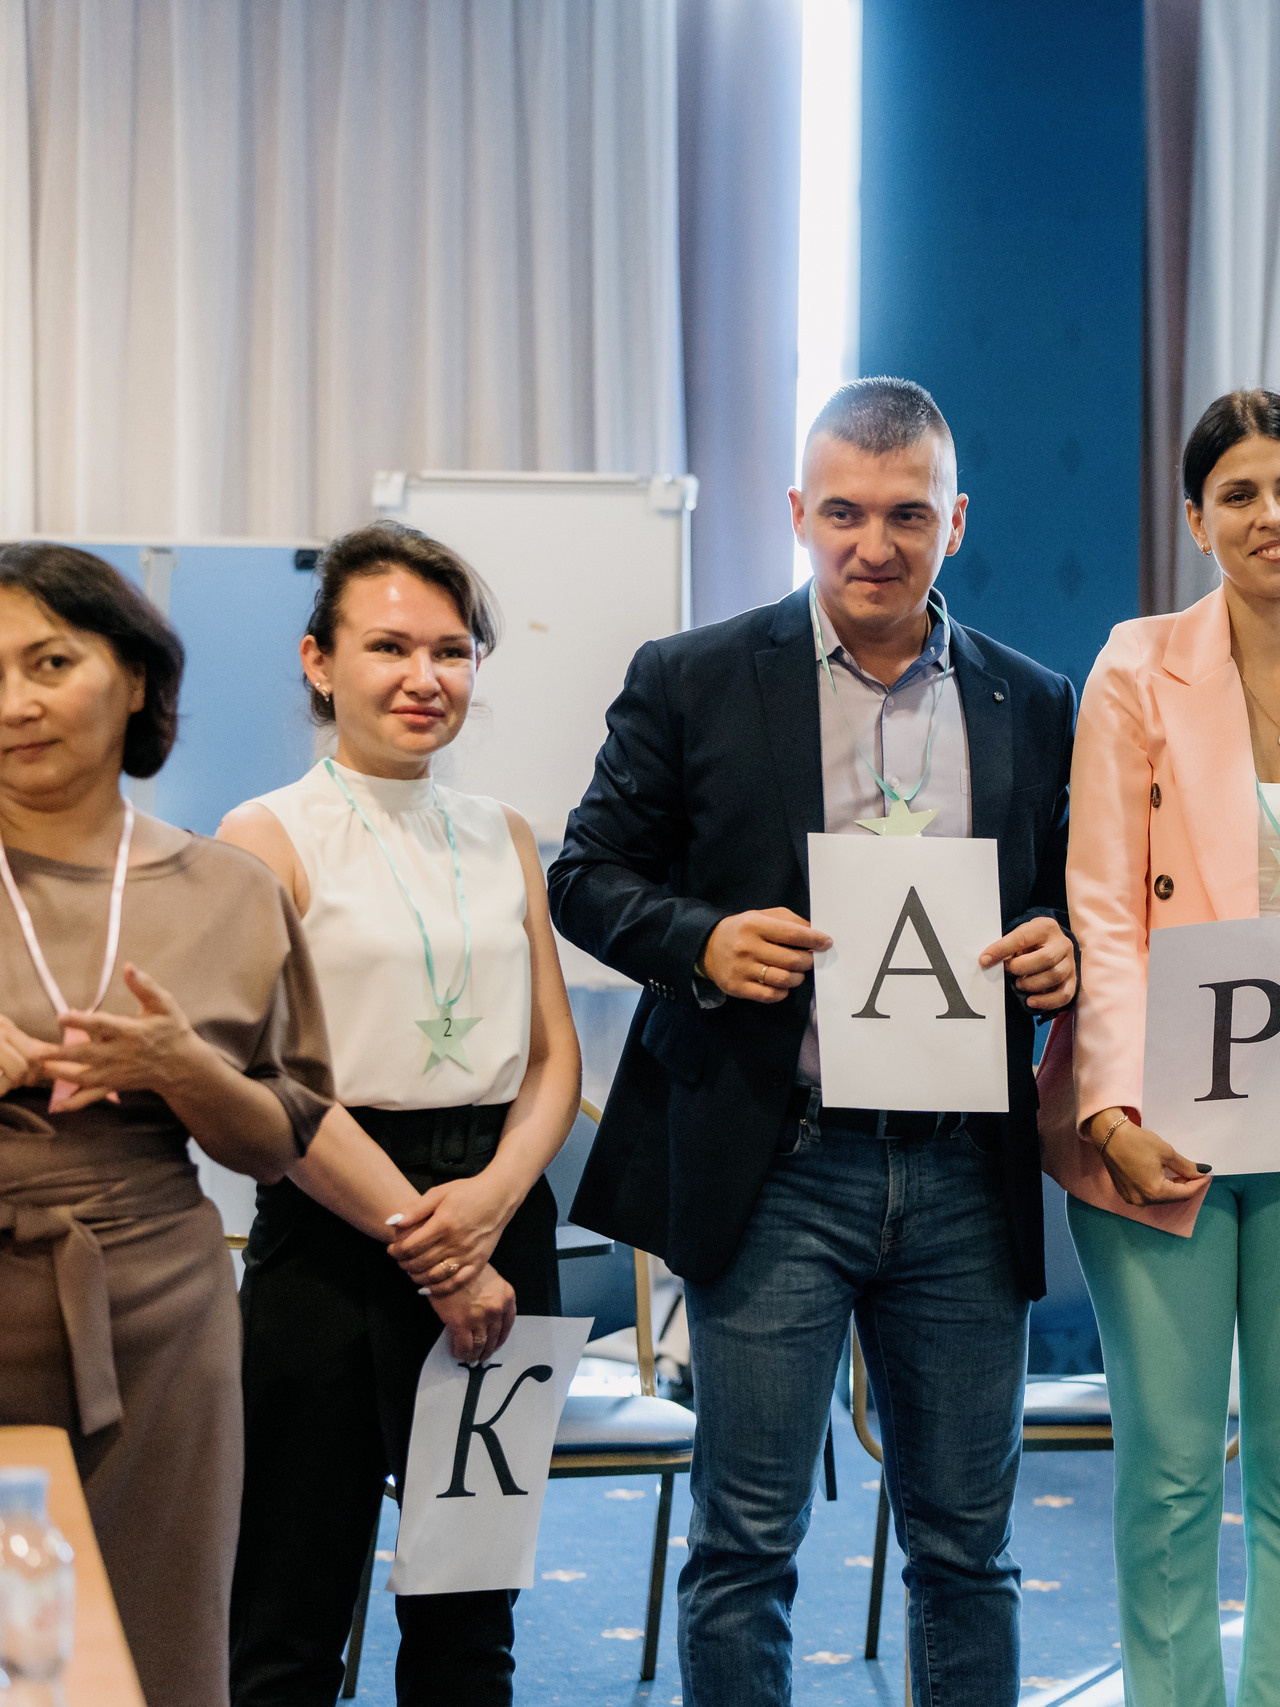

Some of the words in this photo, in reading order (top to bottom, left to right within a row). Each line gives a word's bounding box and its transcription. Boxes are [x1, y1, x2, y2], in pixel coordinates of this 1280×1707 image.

[851, 885, 987, 1020] А
[443, 1018, 453, 1038] 2
[436, 1361, 553, 1499] К
